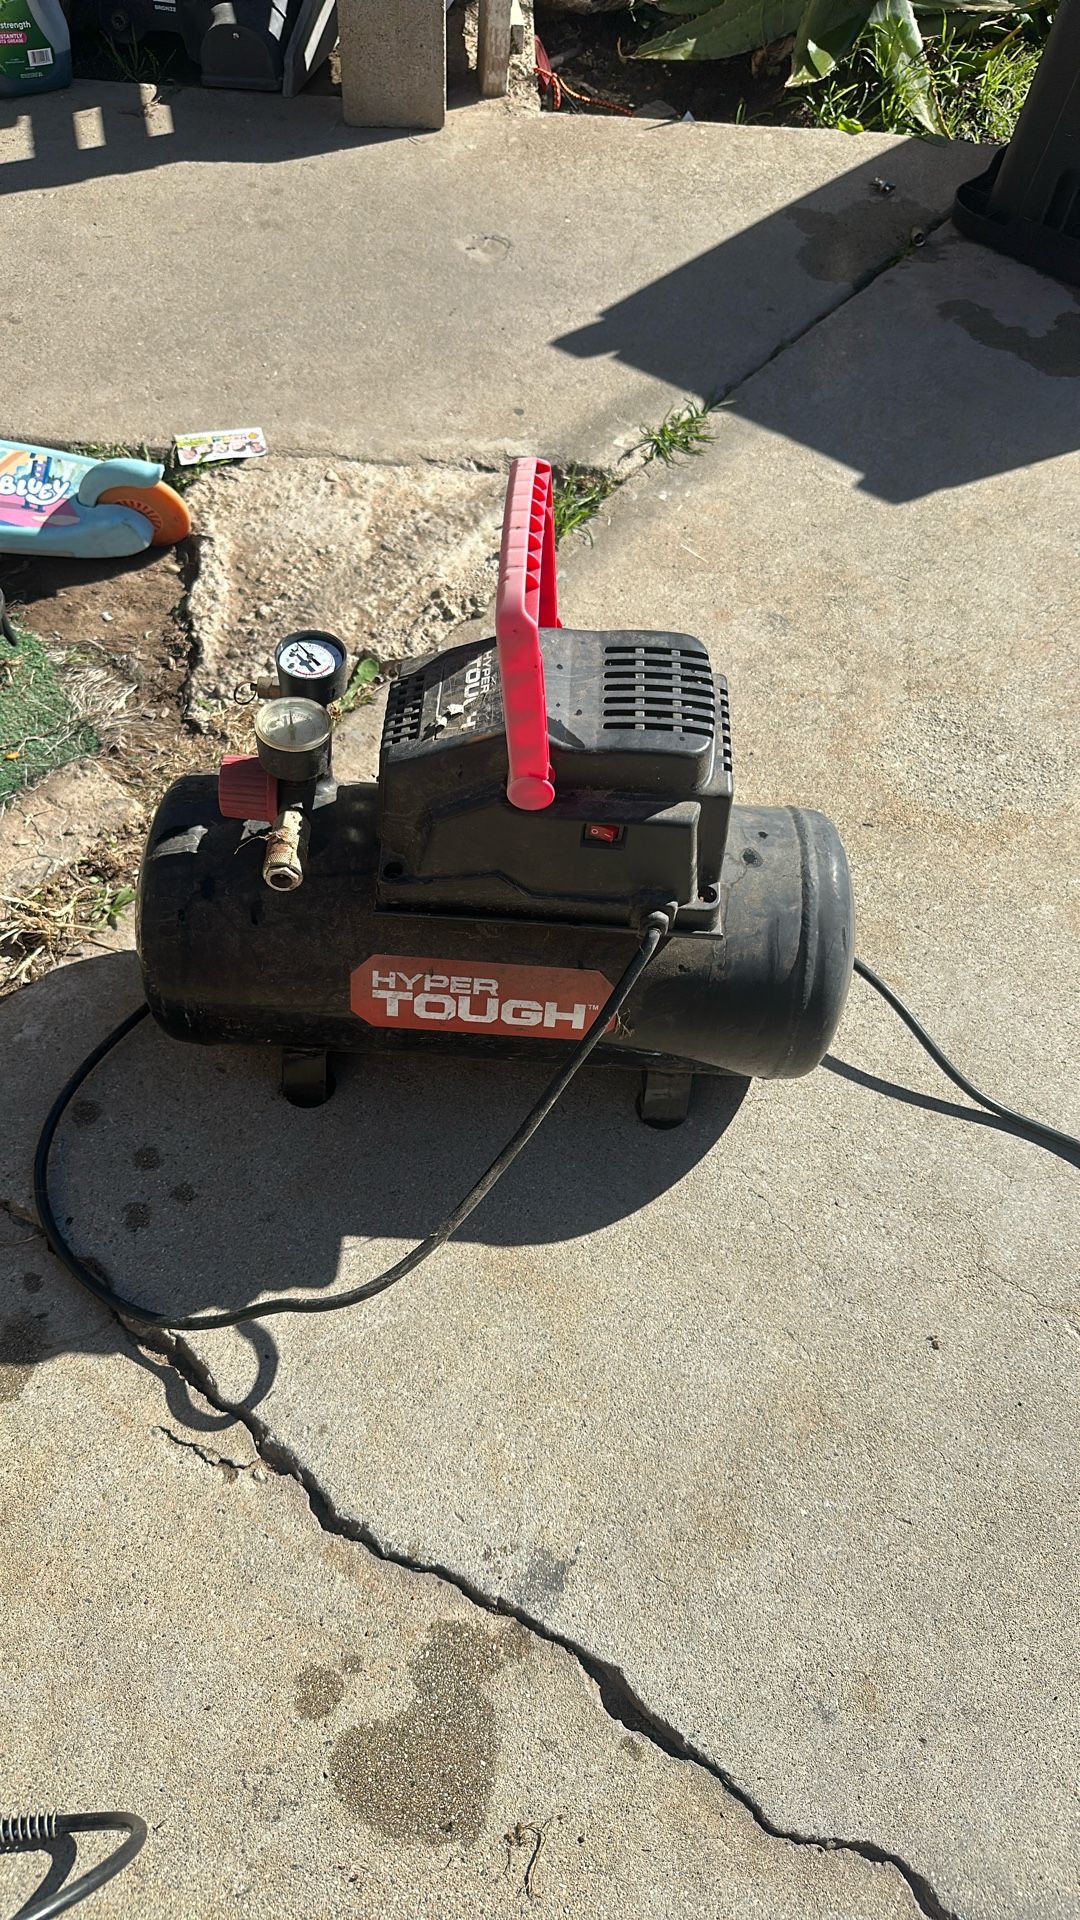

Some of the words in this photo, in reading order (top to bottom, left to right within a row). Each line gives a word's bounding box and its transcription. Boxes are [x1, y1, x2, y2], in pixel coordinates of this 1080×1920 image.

[0, 473, 71, 505] BLUEY
[480, 650, 493, 694] HYPER
[371, 970, 499, 996] HYPER
[371, 989, 587, 1030] TOUGH
